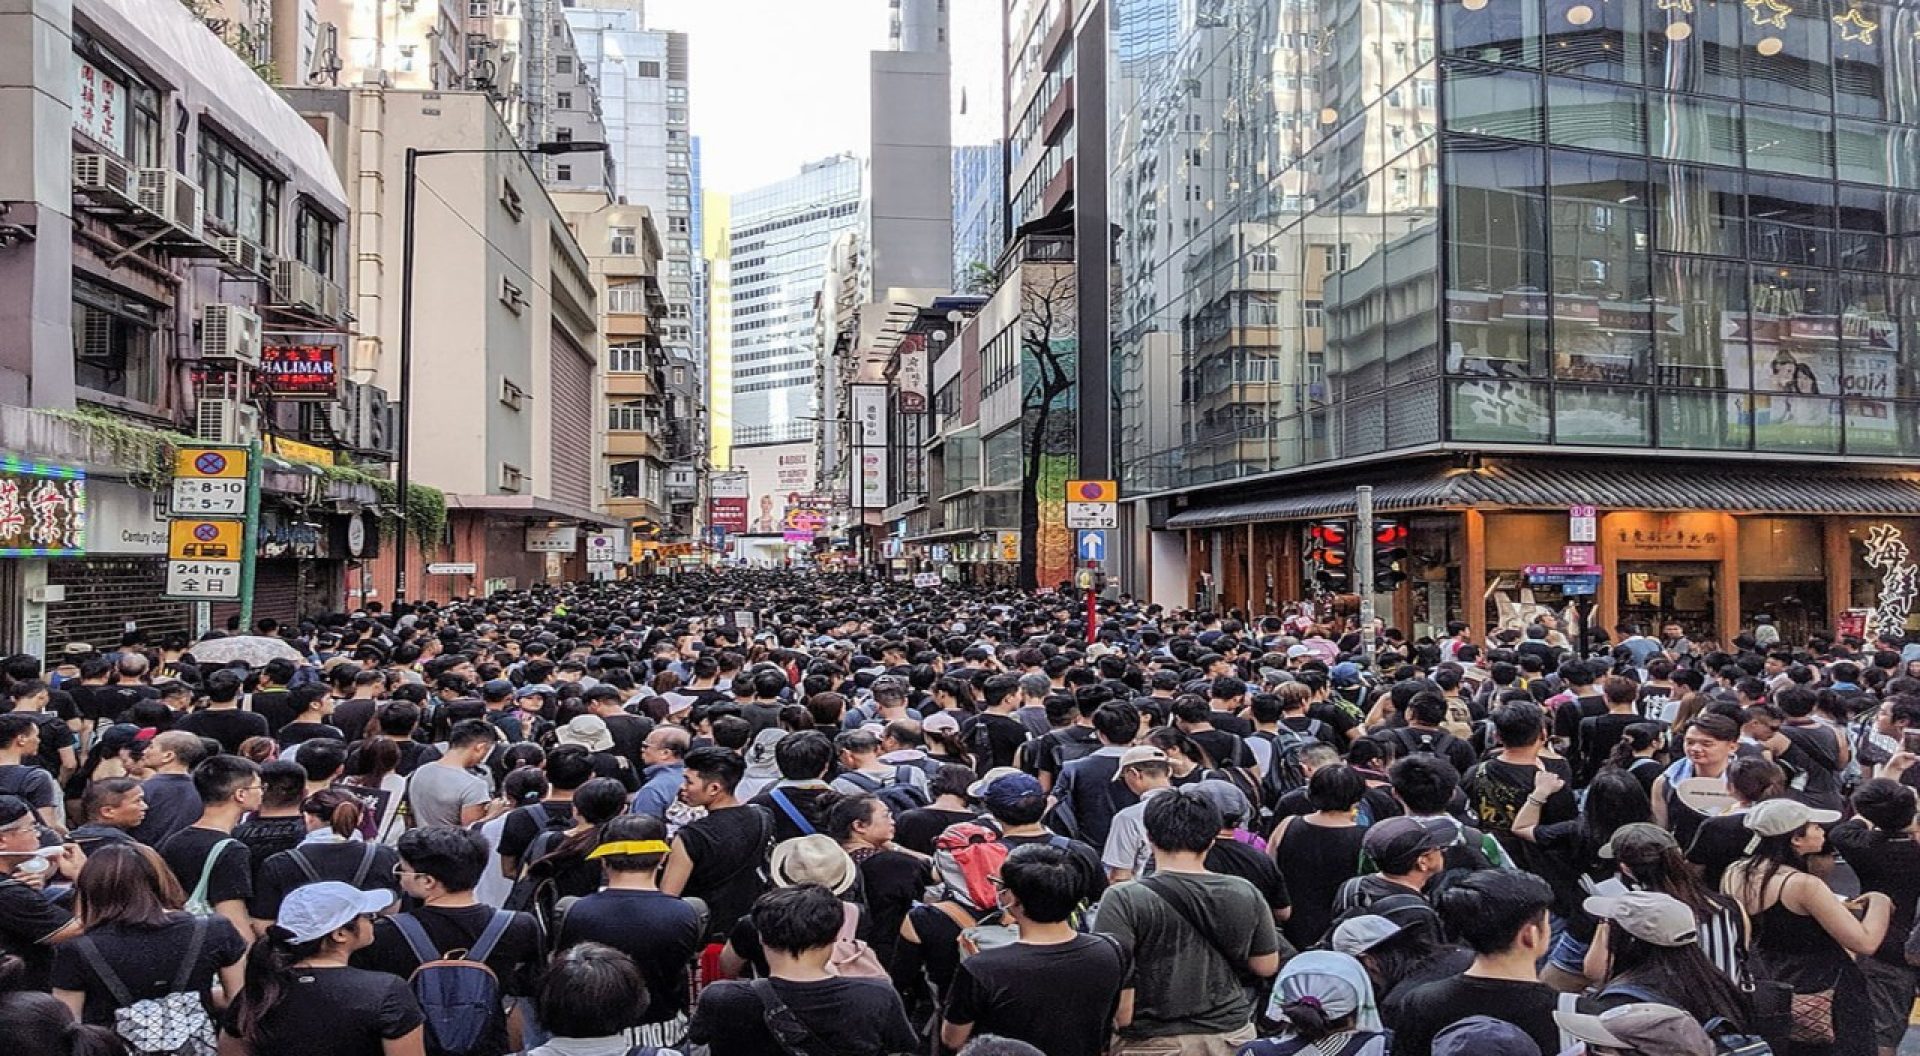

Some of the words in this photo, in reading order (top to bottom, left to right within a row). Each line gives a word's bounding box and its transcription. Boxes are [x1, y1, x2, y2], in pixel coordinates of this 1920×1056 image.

[261, 361, 334, 373] HALIMAR
[201, 482, 242, 493] 8-10
[176, 563, 199, 575] 24
[204, 564, 232, 576] hrs
